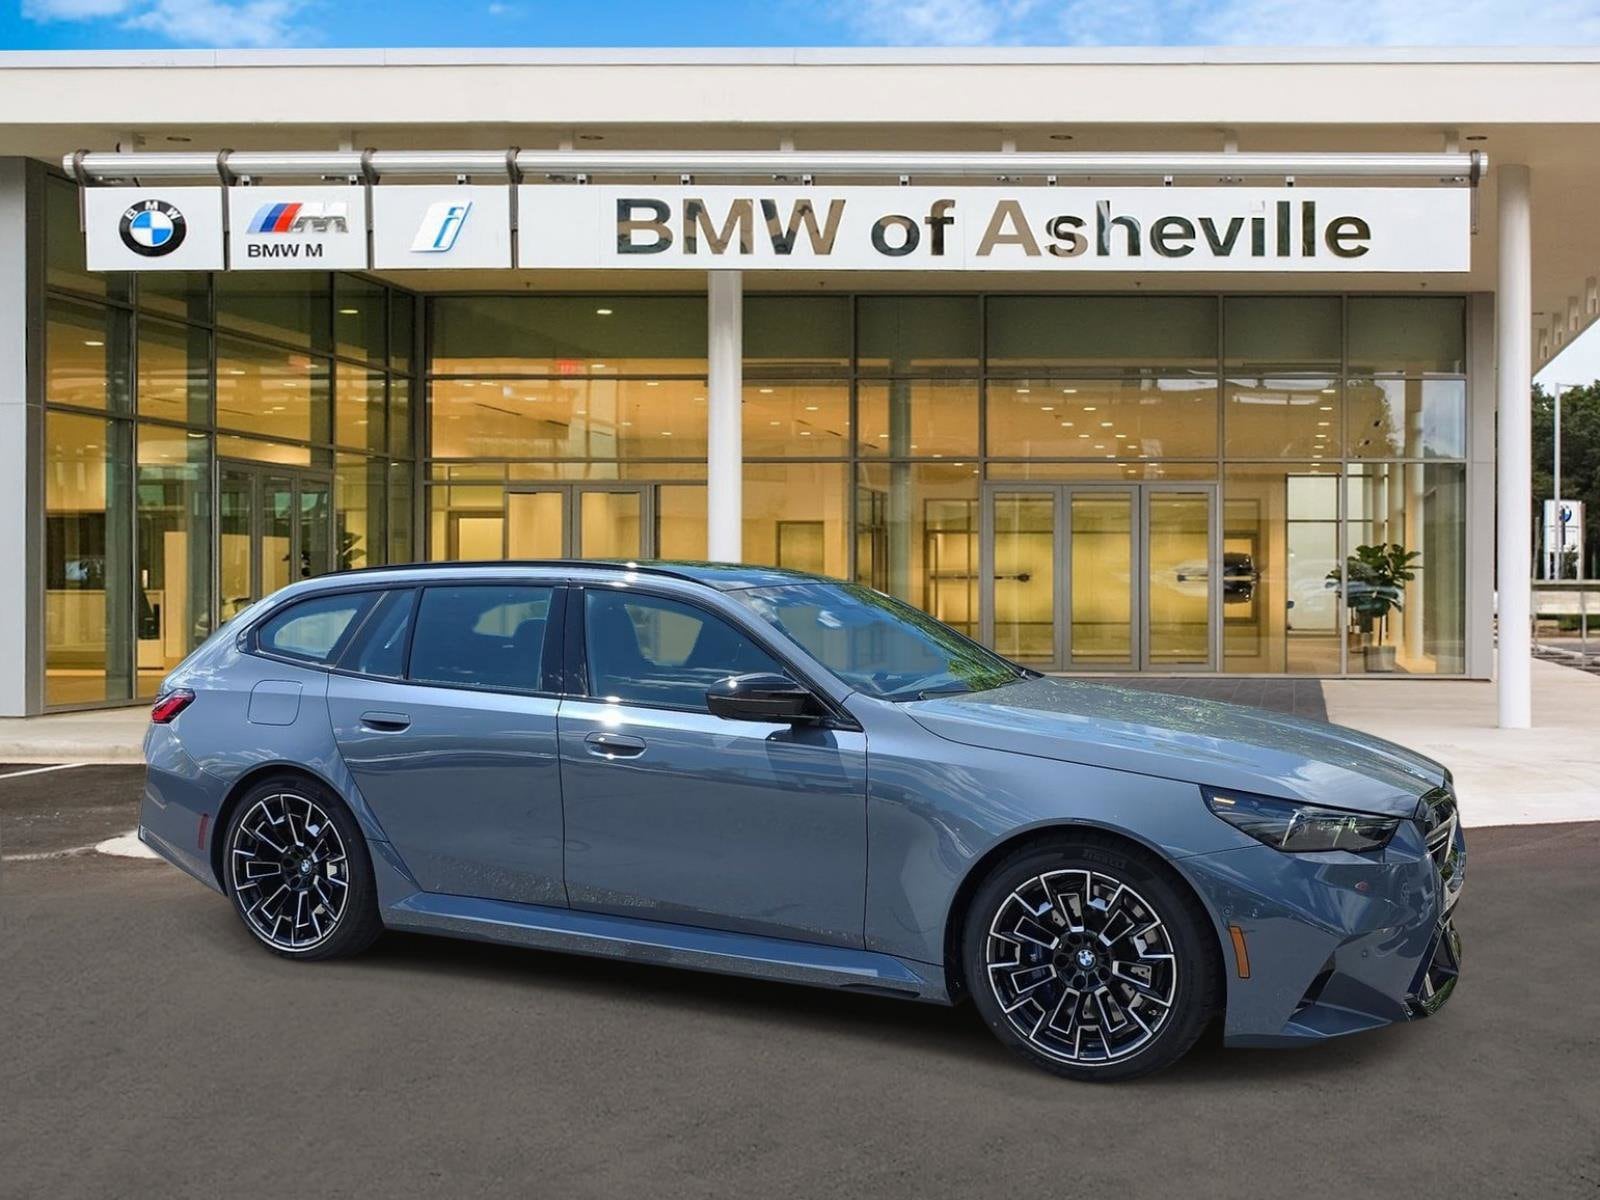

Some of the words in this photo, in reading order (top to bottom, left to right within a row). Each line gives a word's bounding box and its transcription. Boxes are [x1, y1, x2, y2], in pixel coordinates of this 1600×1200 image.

[124, 200, 181, 220] BMW
[616, 198, 846, 255] BMW
[871, 199, 956, 257] of
[975, 199, 1372, 258] Asheville
[247, 244, 300, 258] BMW
[305, 243, 323, 258] M
